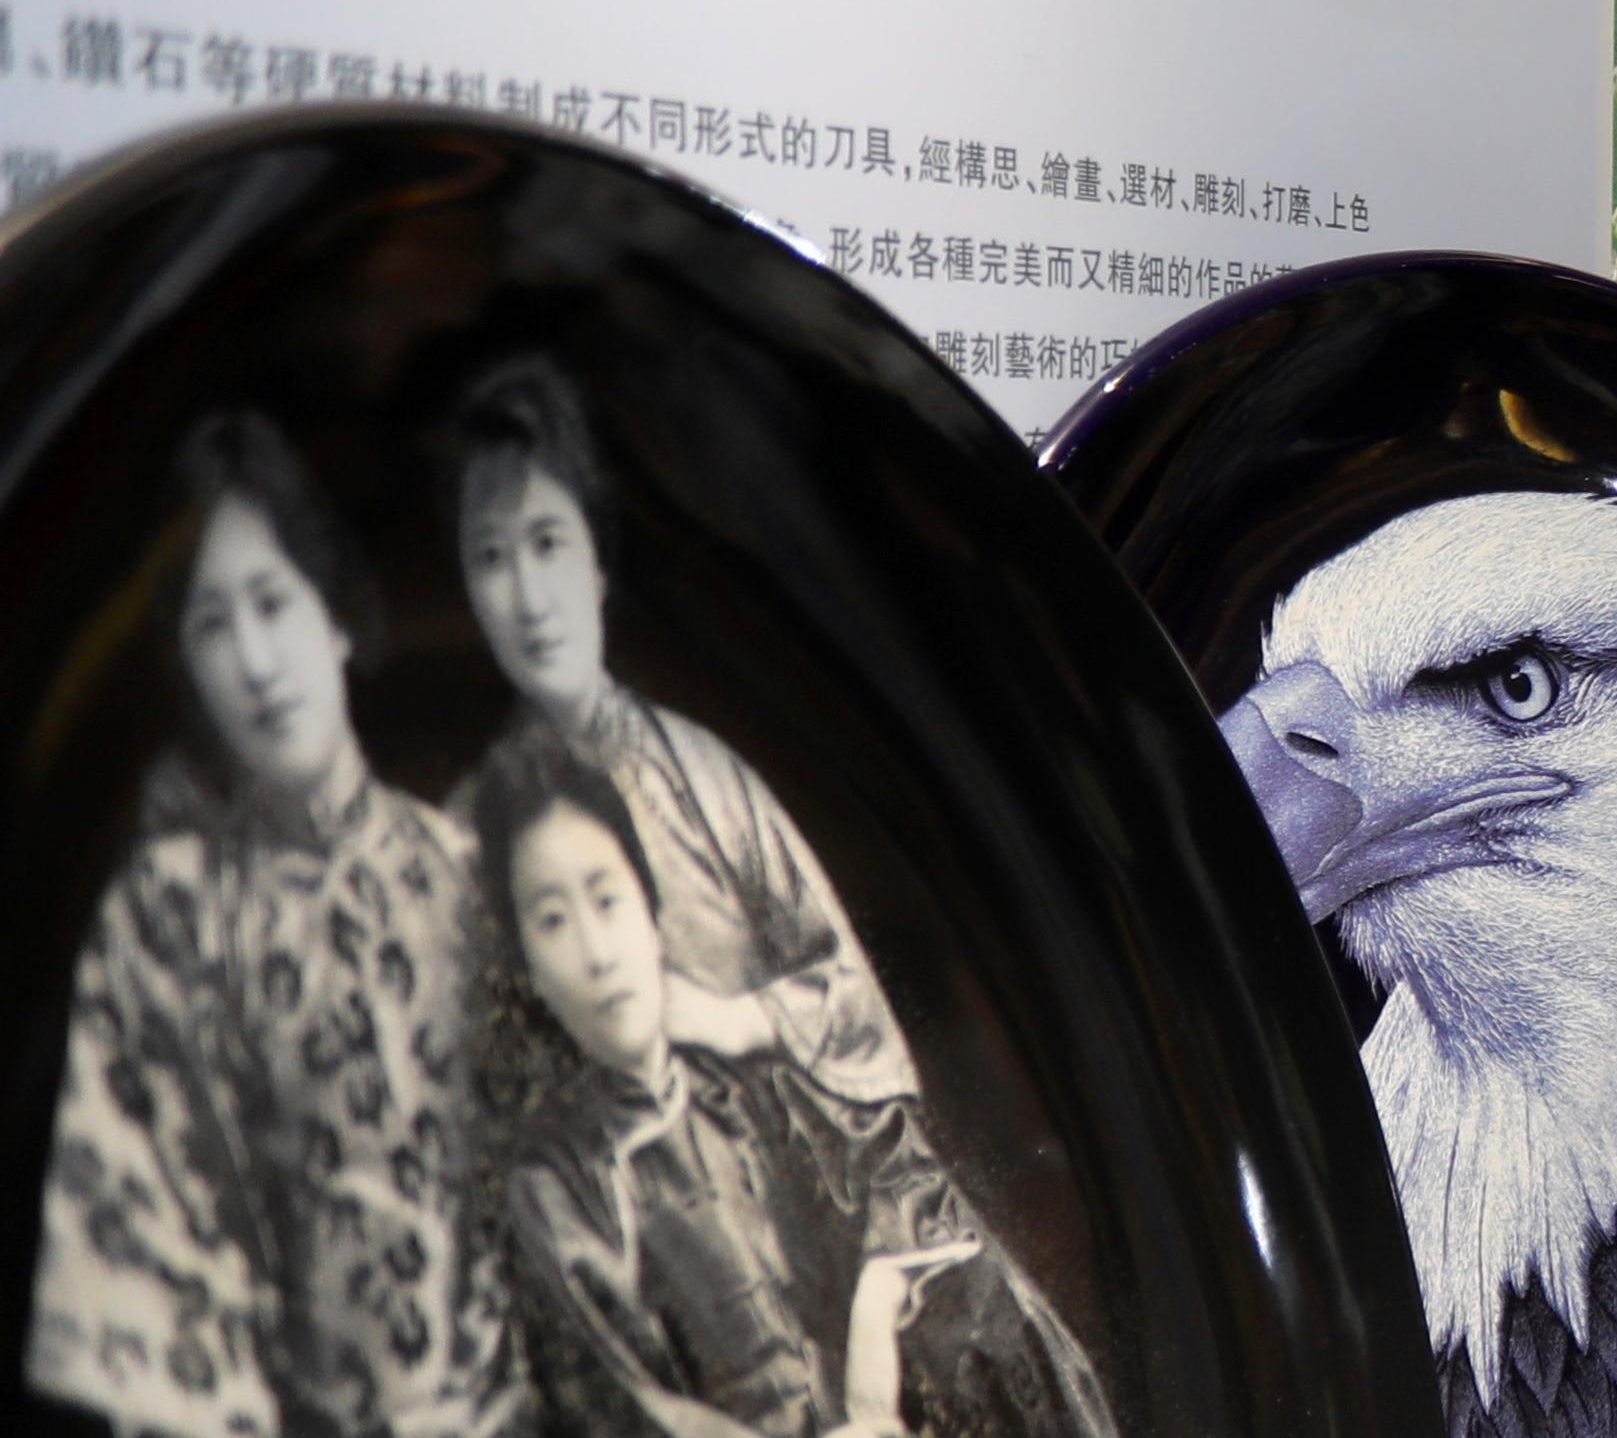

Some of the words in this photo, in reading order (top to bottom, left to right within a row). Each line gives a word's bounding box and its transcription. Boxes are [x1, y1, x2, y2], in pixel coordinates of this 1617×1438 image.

[922, 331, 1142, 381] 雕刻藝術的巧
